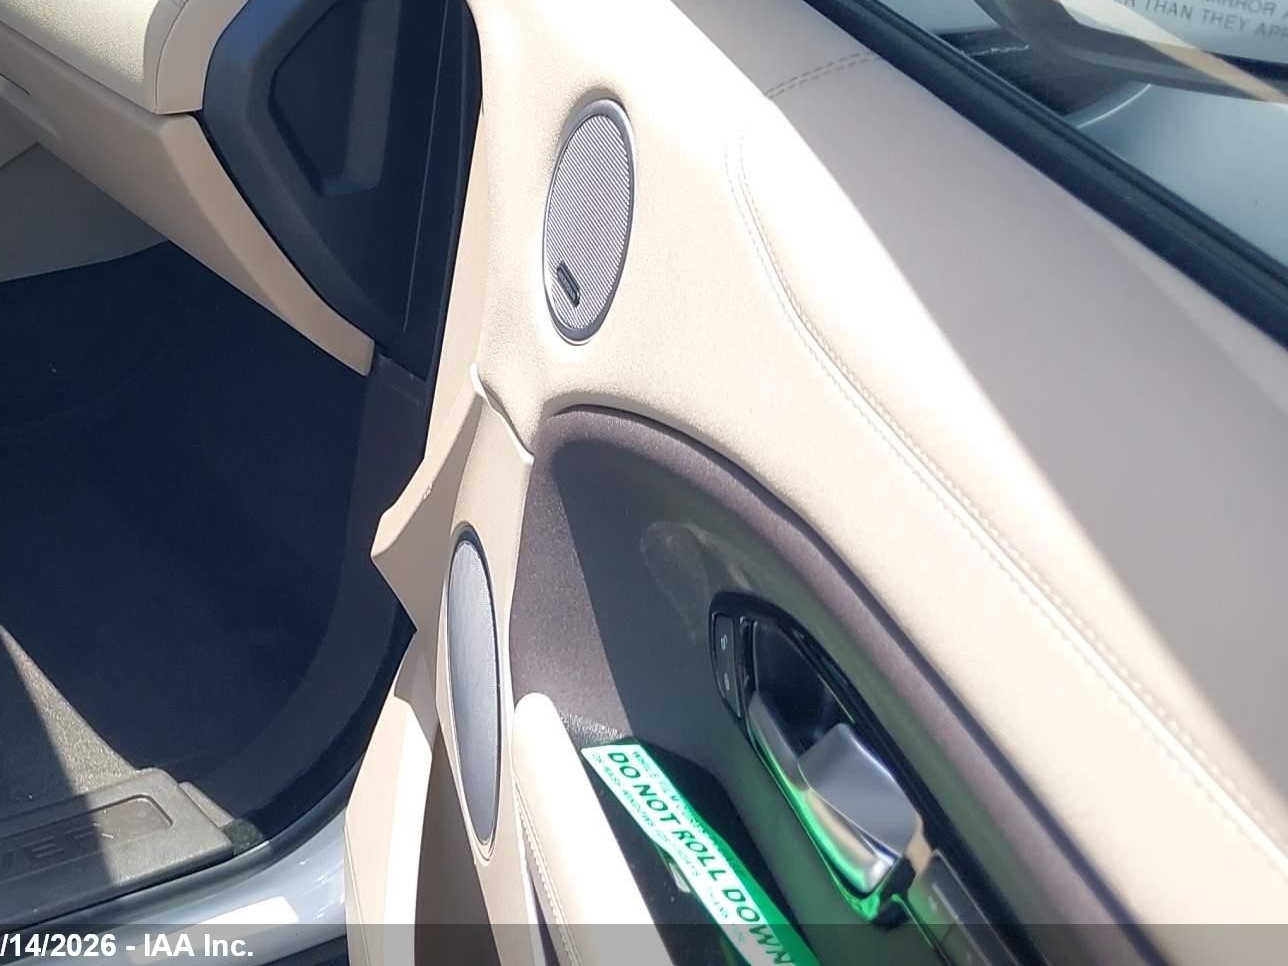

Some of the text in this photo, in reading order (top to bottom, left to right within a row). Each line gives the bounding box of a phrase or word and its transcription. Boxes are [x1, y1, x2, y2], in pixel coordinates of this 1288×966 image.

[1202, 8, 1250, 33] THEY
[607, 752, 641, 778] DO
[632, 784, 681, 825] NOT
[672, 829, 727, 881] ROLL
[721, 888, 796, 965] DOWN
